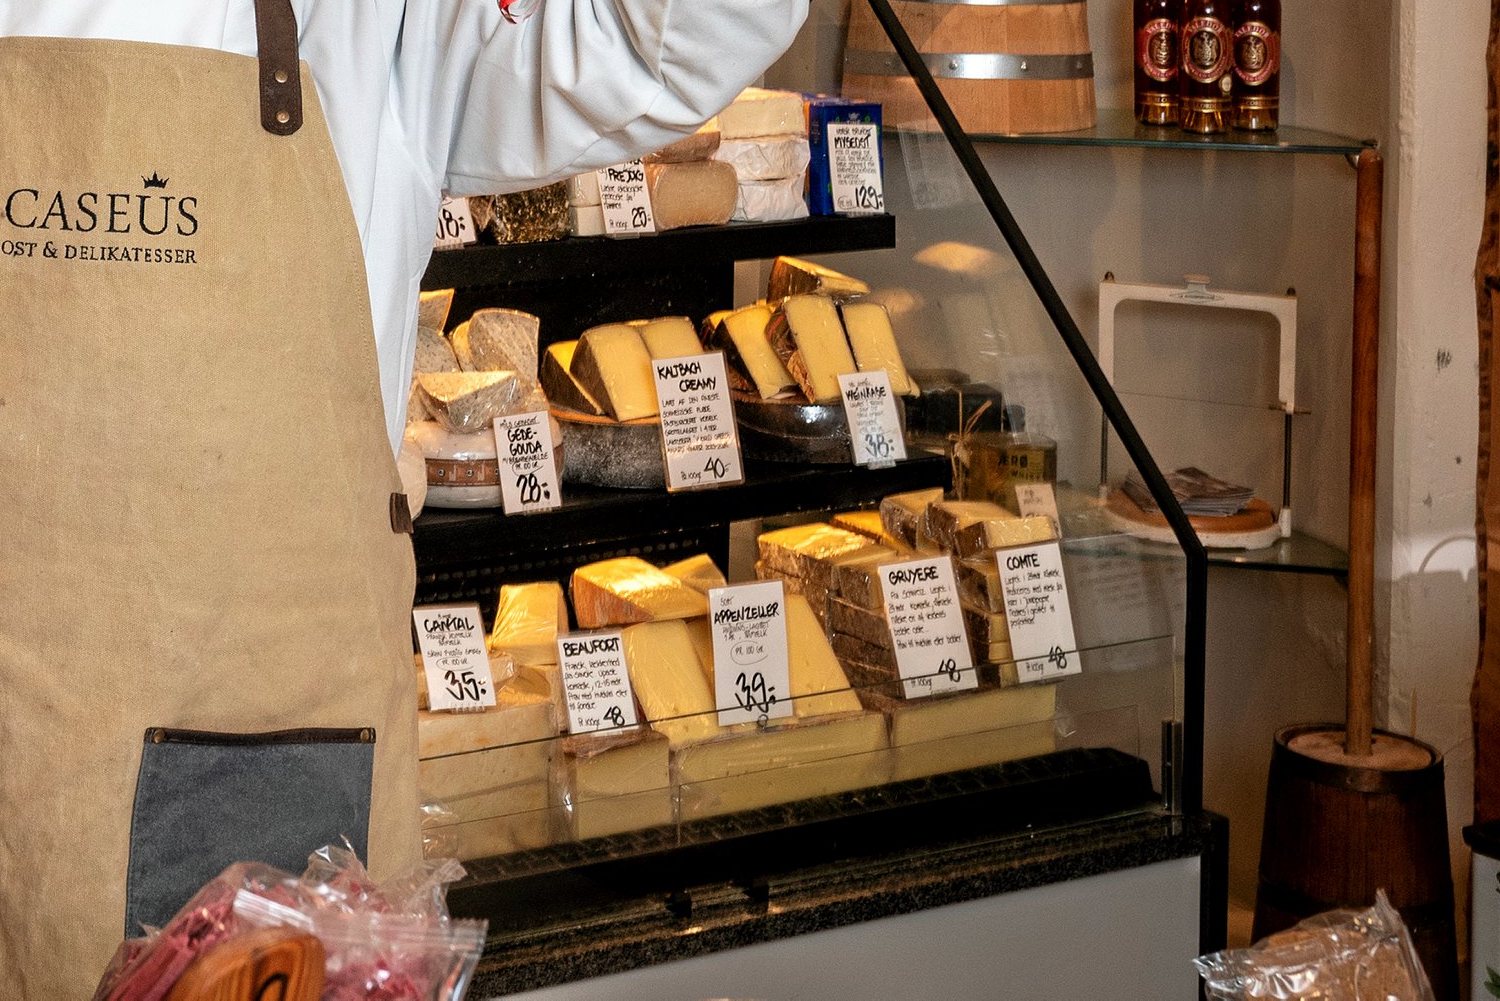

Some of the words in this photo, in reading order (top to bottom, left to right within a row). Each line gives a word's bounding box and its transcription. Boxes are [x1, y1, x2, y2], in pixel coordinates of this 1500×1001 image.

[834, 134, 871, 149] MYSEOST
[4, 188, 198, 237] CASEUS
[1, 240, 37, 258] OST
[43, 241, 58, 258] &
[64, 244, 198, 264] DELIKATESSER
[657, 362, 702, 380] KALTBACH
[680, 377, 716, 392] CREAMY
[509, 441, 542, 456] GOUDA
[1006, 553, 1040, 570] COMTE
[889, 566, 939, 586] GRUYERE
[714, 602, 779, 624] APPENZELLER
[424, 617, 475, 633] CANTAL
[563, 638, 620, 657] BEAUFORT
[1048, 646, 1067, 670] 48
[603, 706, 625, 727] 48
